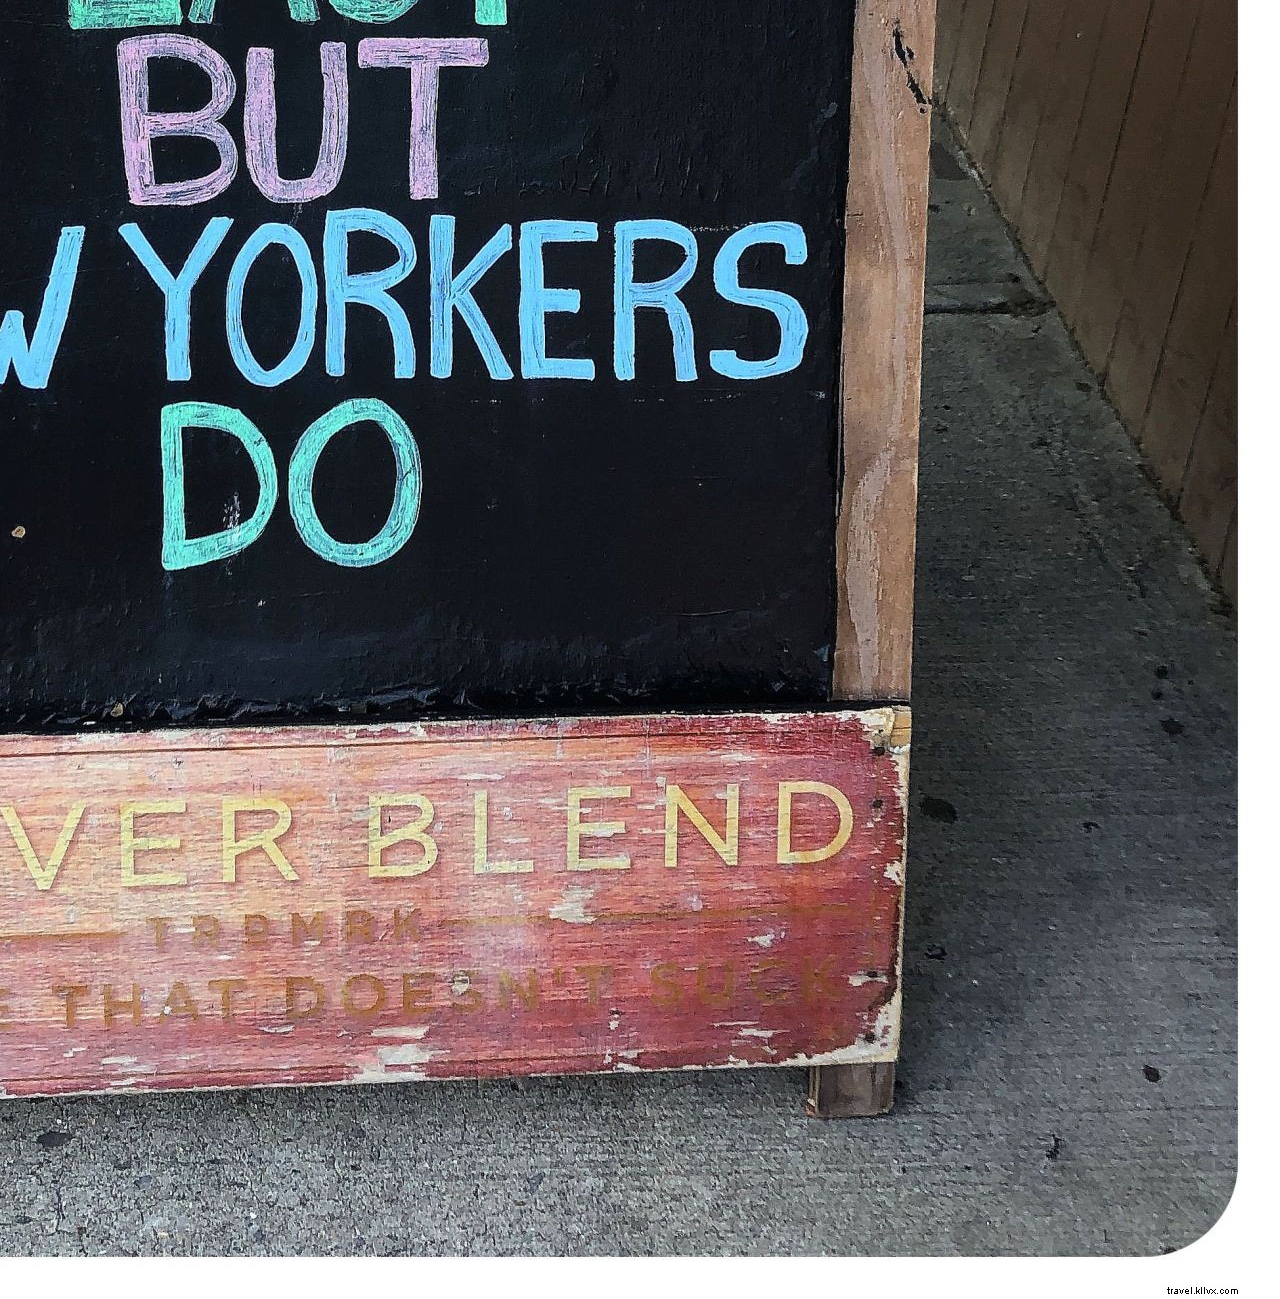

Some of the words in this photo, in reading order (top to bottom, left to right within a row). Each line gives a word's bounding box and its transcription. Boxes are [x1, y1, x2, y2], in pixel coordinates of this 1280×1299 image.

[116, 34, 490, 206] BUT
[117, 207, 809, 388] YORKERS
[160, 396, 423, 571] DO
[366, 778, 856, 880] BLEND
[50, 977, 244, 1030] THAT
[284, 963, 614, 1021] DOESN'T
[649, 955, 840, 1004] SUCK
